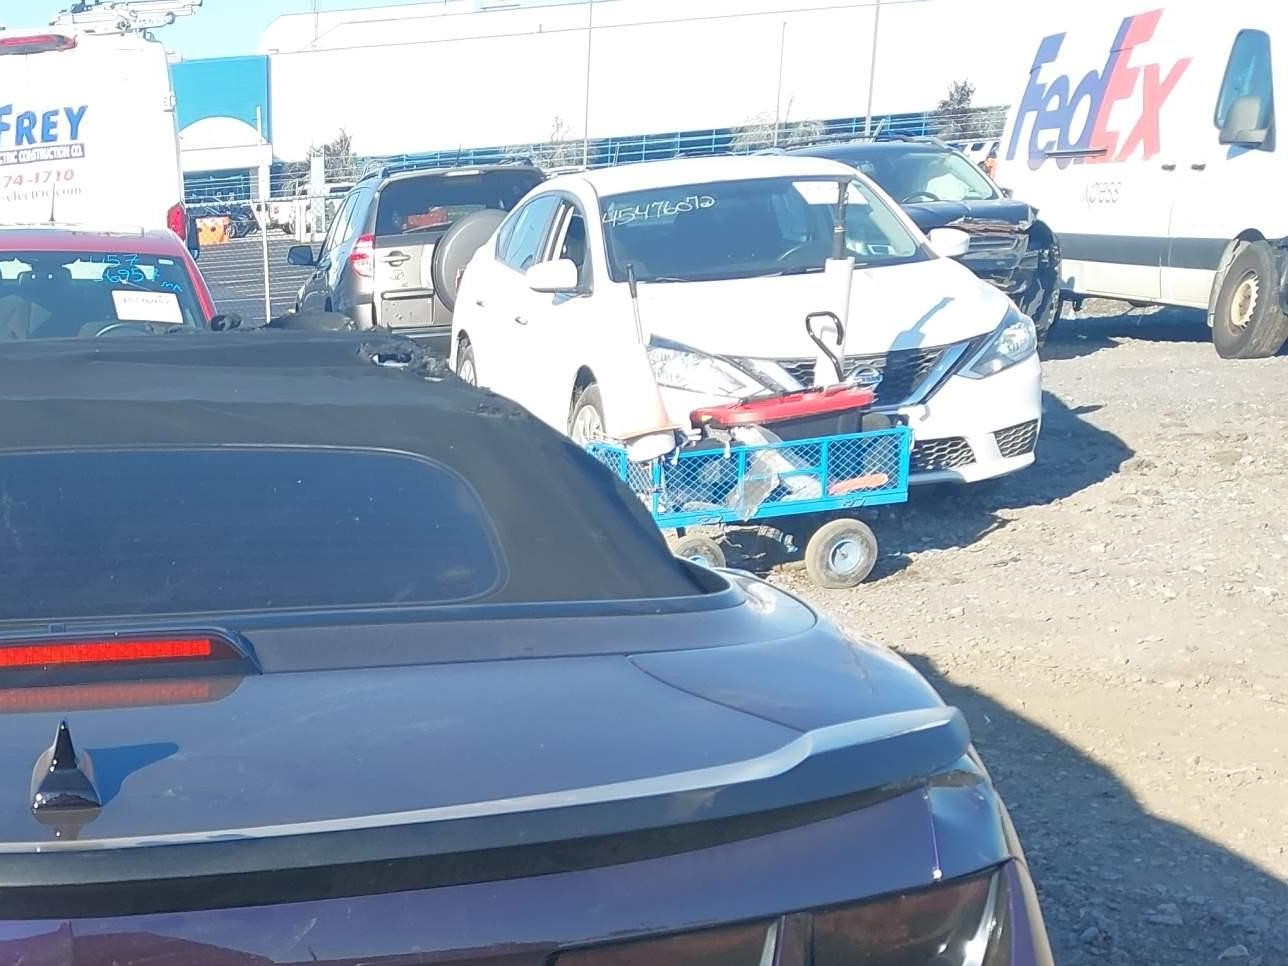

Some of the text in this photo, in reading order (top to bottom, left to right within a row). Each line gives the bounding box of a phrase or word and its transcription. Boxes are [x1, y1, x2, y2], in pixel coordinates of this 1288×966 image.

[1006, 8, 1193, 171] FedEx
[18, 145, 70, 163] CONSTRUCTION
[602, 195, 715, 227] 45476072
